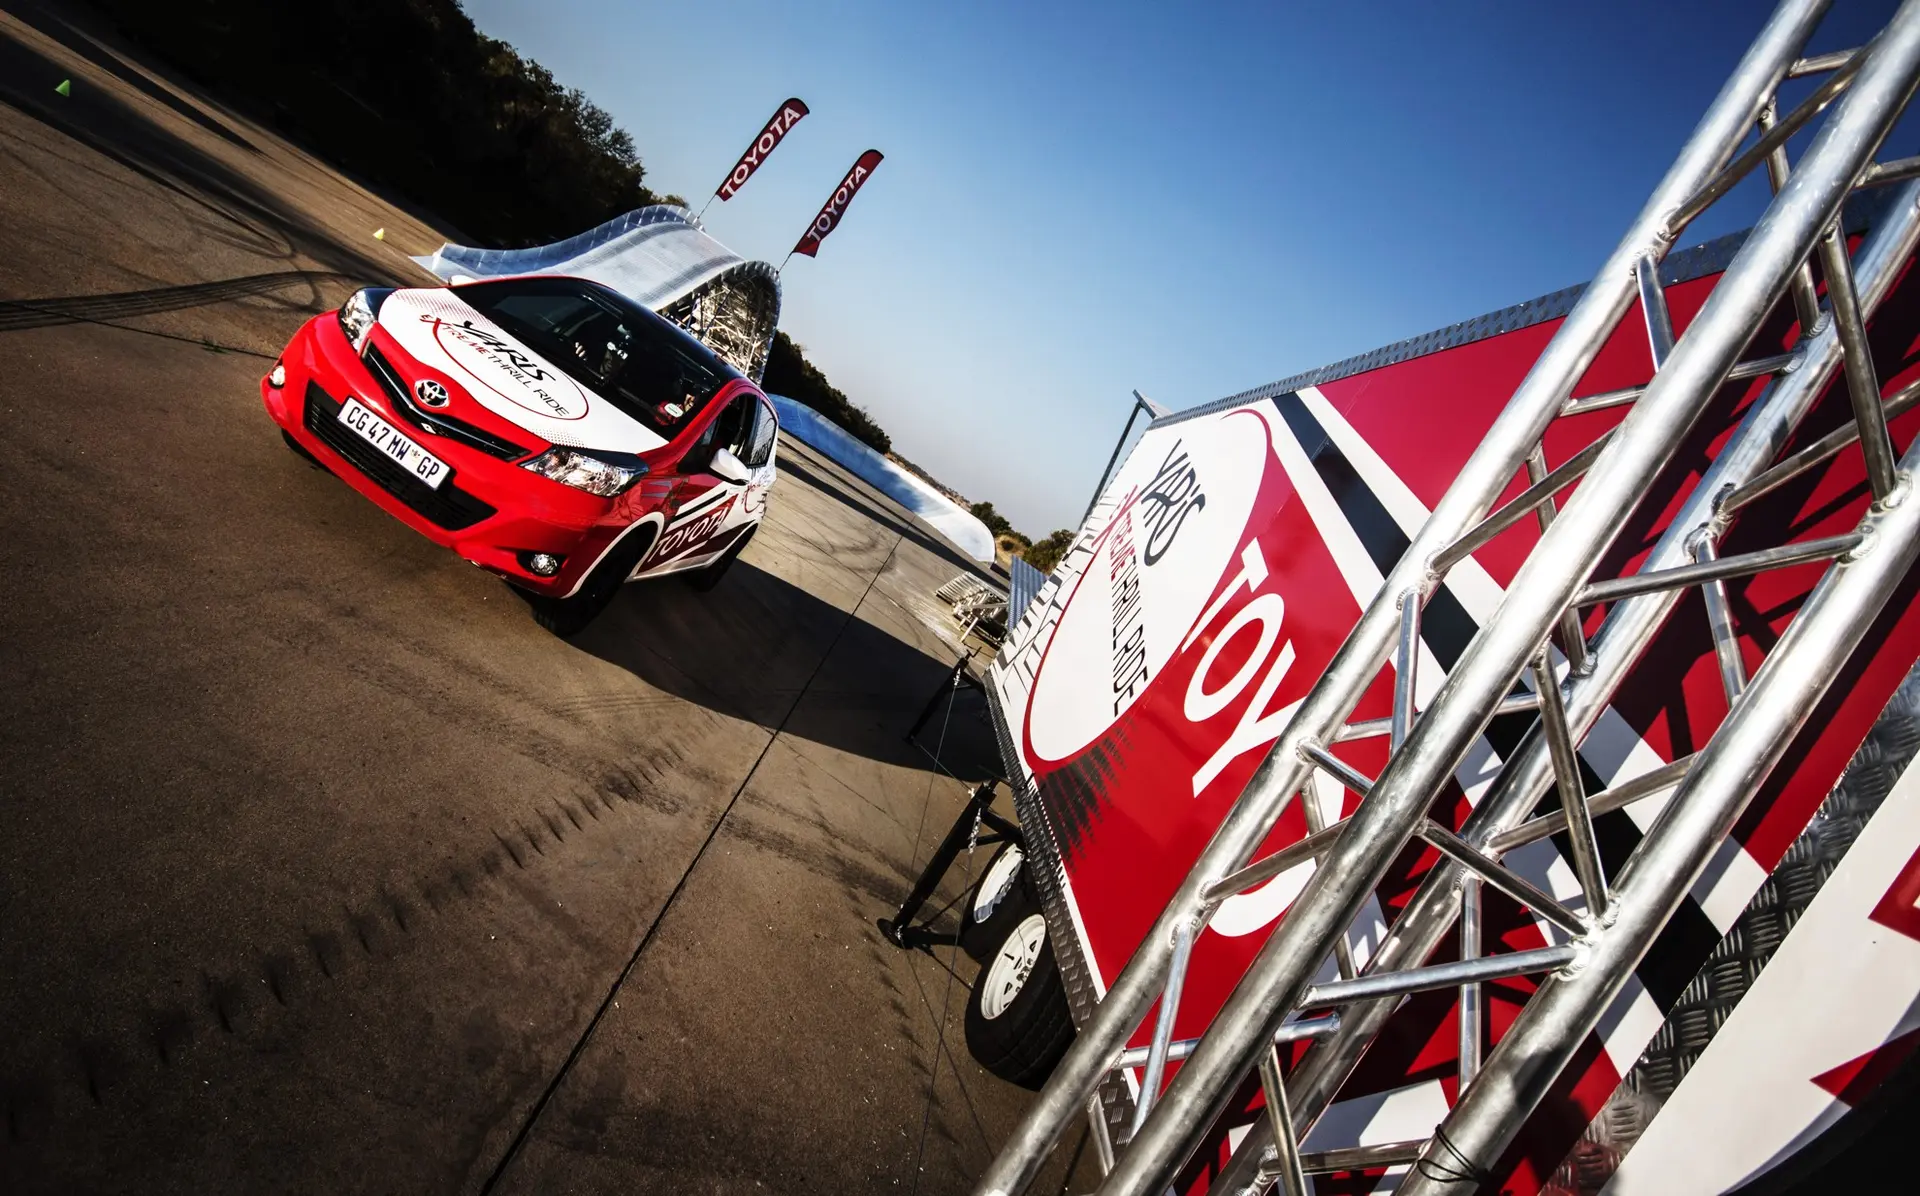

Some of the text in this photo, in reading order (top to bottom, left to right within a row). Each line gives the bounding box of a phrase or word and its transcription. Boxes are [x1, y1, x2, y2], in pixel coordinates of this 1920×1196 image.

[721, 106, 801, 196] TOYOTA
[807, 165, 867, 242] TOYOTA
[419, 314, 569, 416] EXTREME THRILL RIDE
[452, 320, 556, 382] YARIS
[347, 406, 440, 479] CG 47 MW GP
[647, 506, 730, 563] TOYOTA
[1138, 438, 1206, 567] YARIS
[1091, 484, 1148, 717] EXTREME THRILL RIDE
